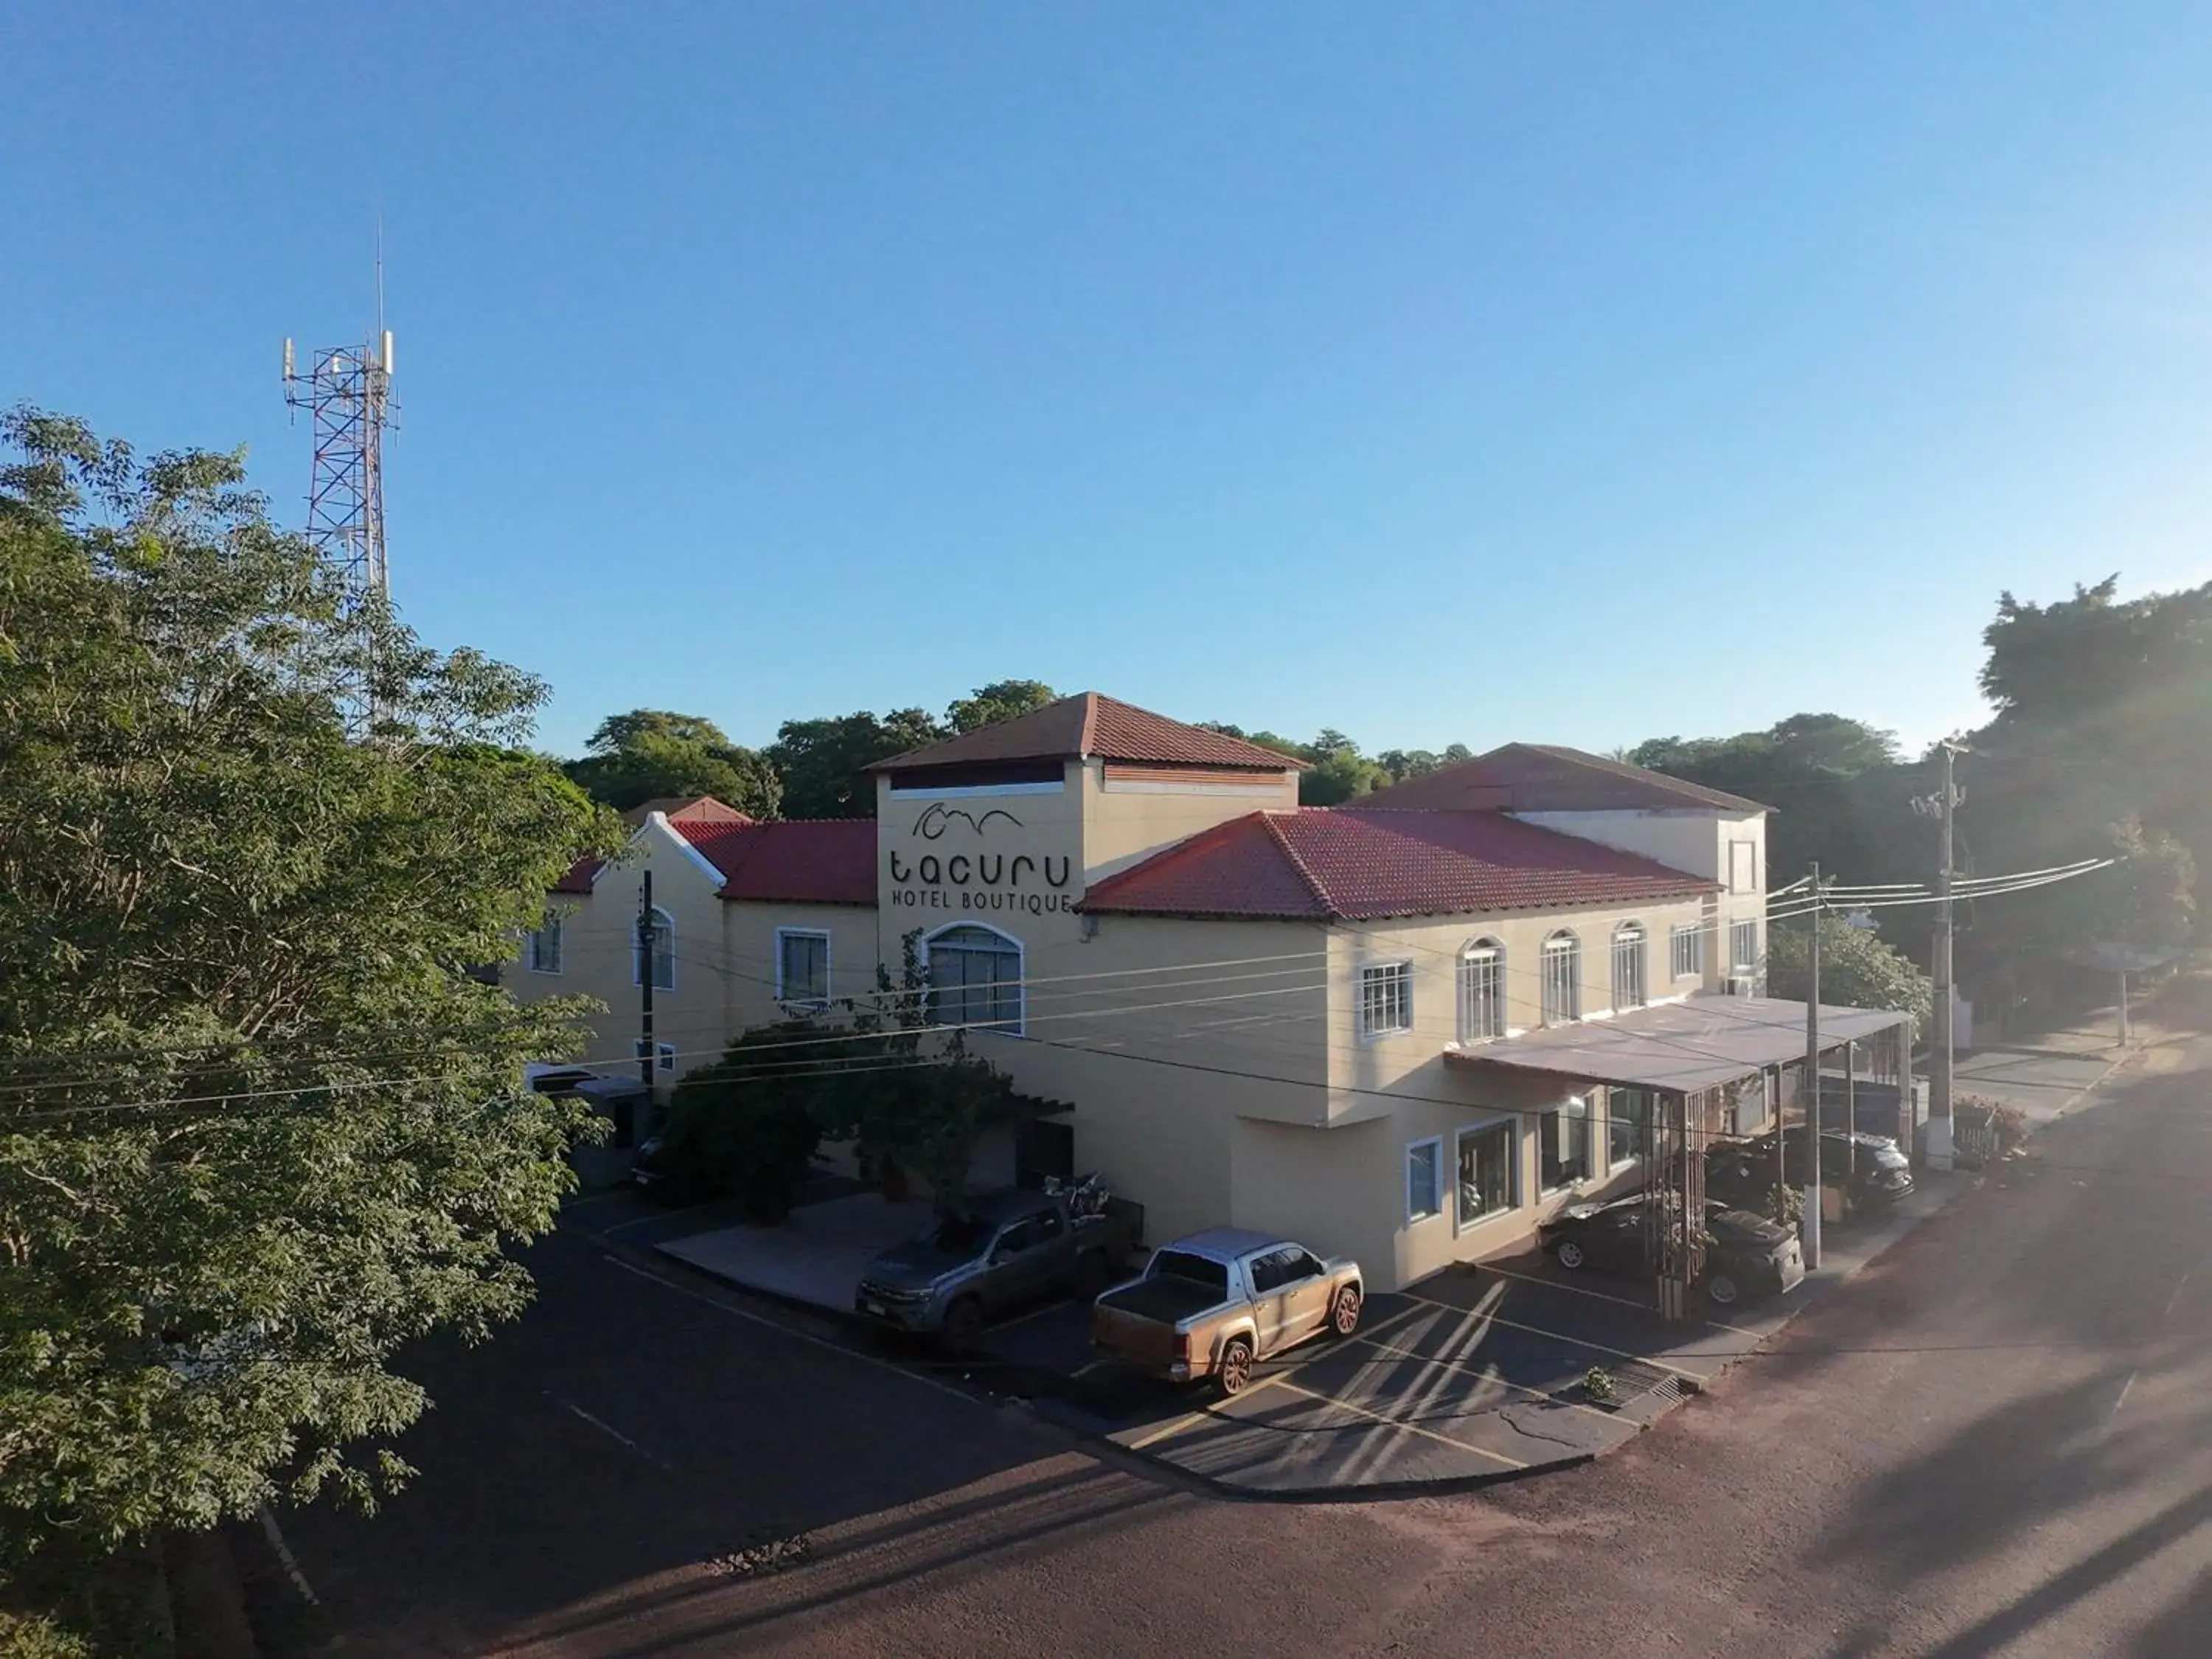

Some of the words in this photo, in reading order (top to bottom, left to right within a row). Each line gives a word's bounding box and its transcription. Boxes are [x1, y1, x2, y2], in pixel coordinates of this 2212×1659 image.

[891, 850, 1069, 887] tacuru
[892, 890, 951, 908] HOTEL
[962, 892, 1071, 916] BOUTIQUE
